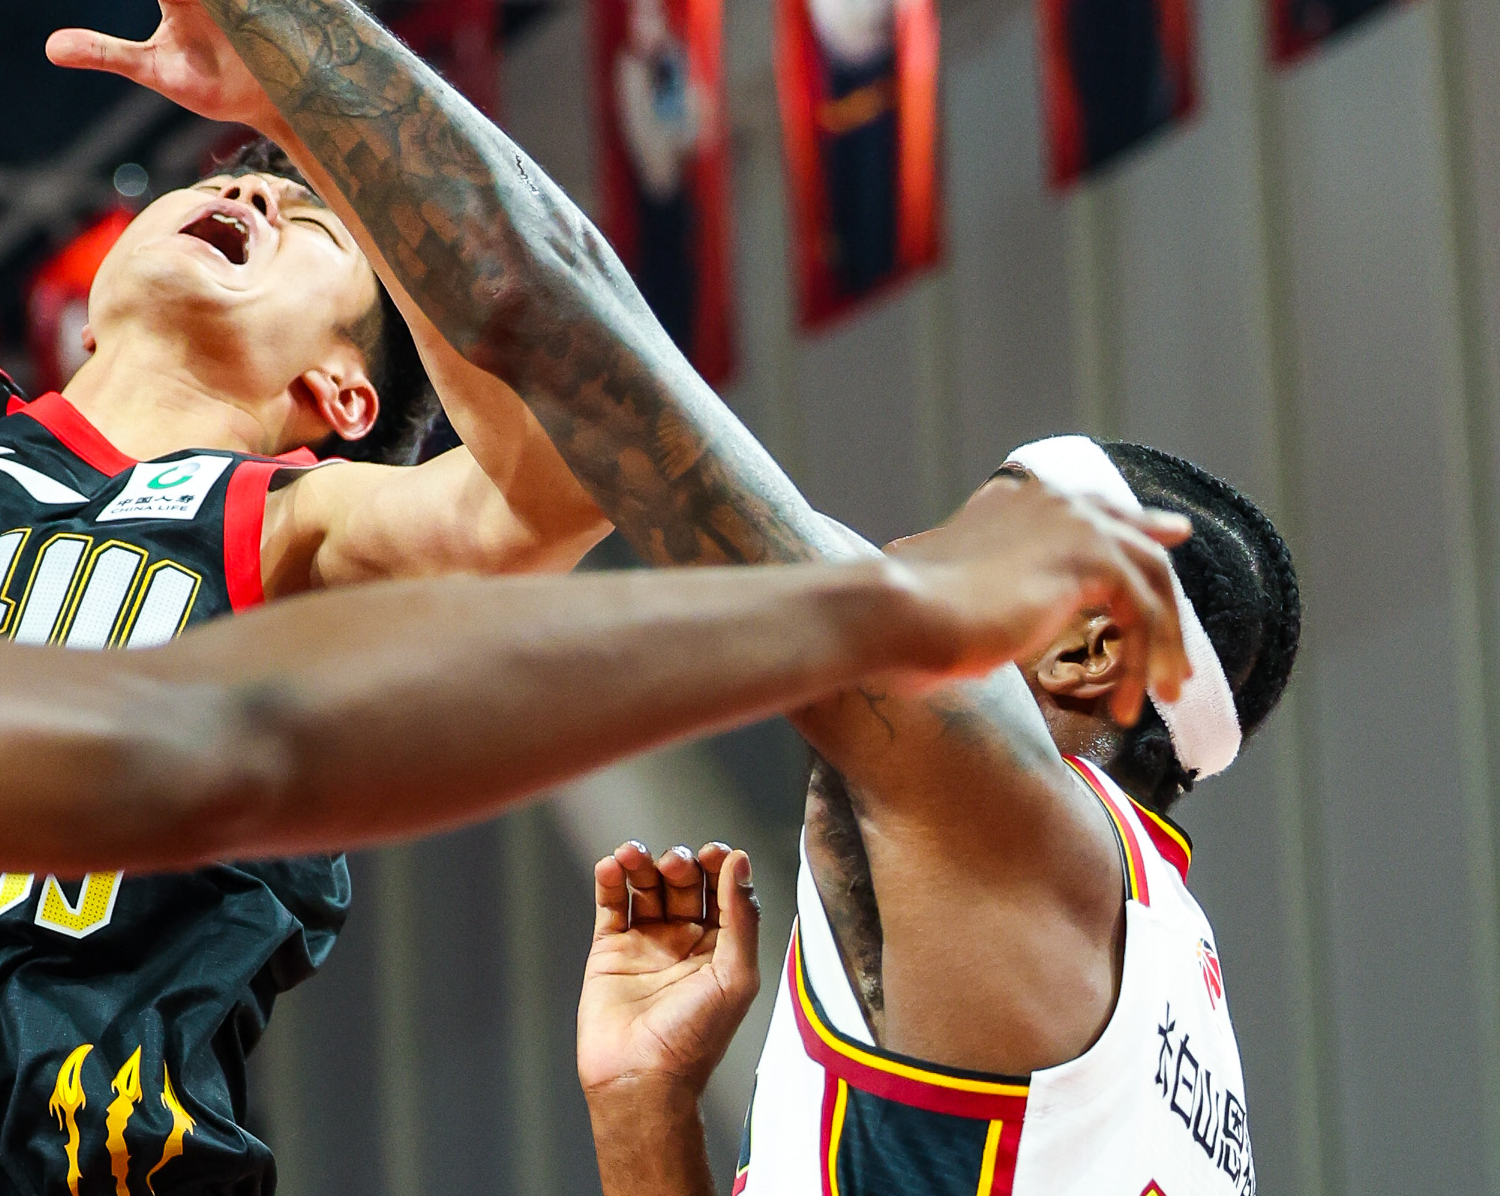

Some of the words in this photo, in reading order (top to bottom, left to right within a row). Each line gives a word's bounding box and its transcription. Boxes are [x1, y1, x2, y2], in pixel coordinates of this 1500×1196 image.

[116, 494, 195, 506] 中国人寿
[110, 505, 152, 514] CHINA
